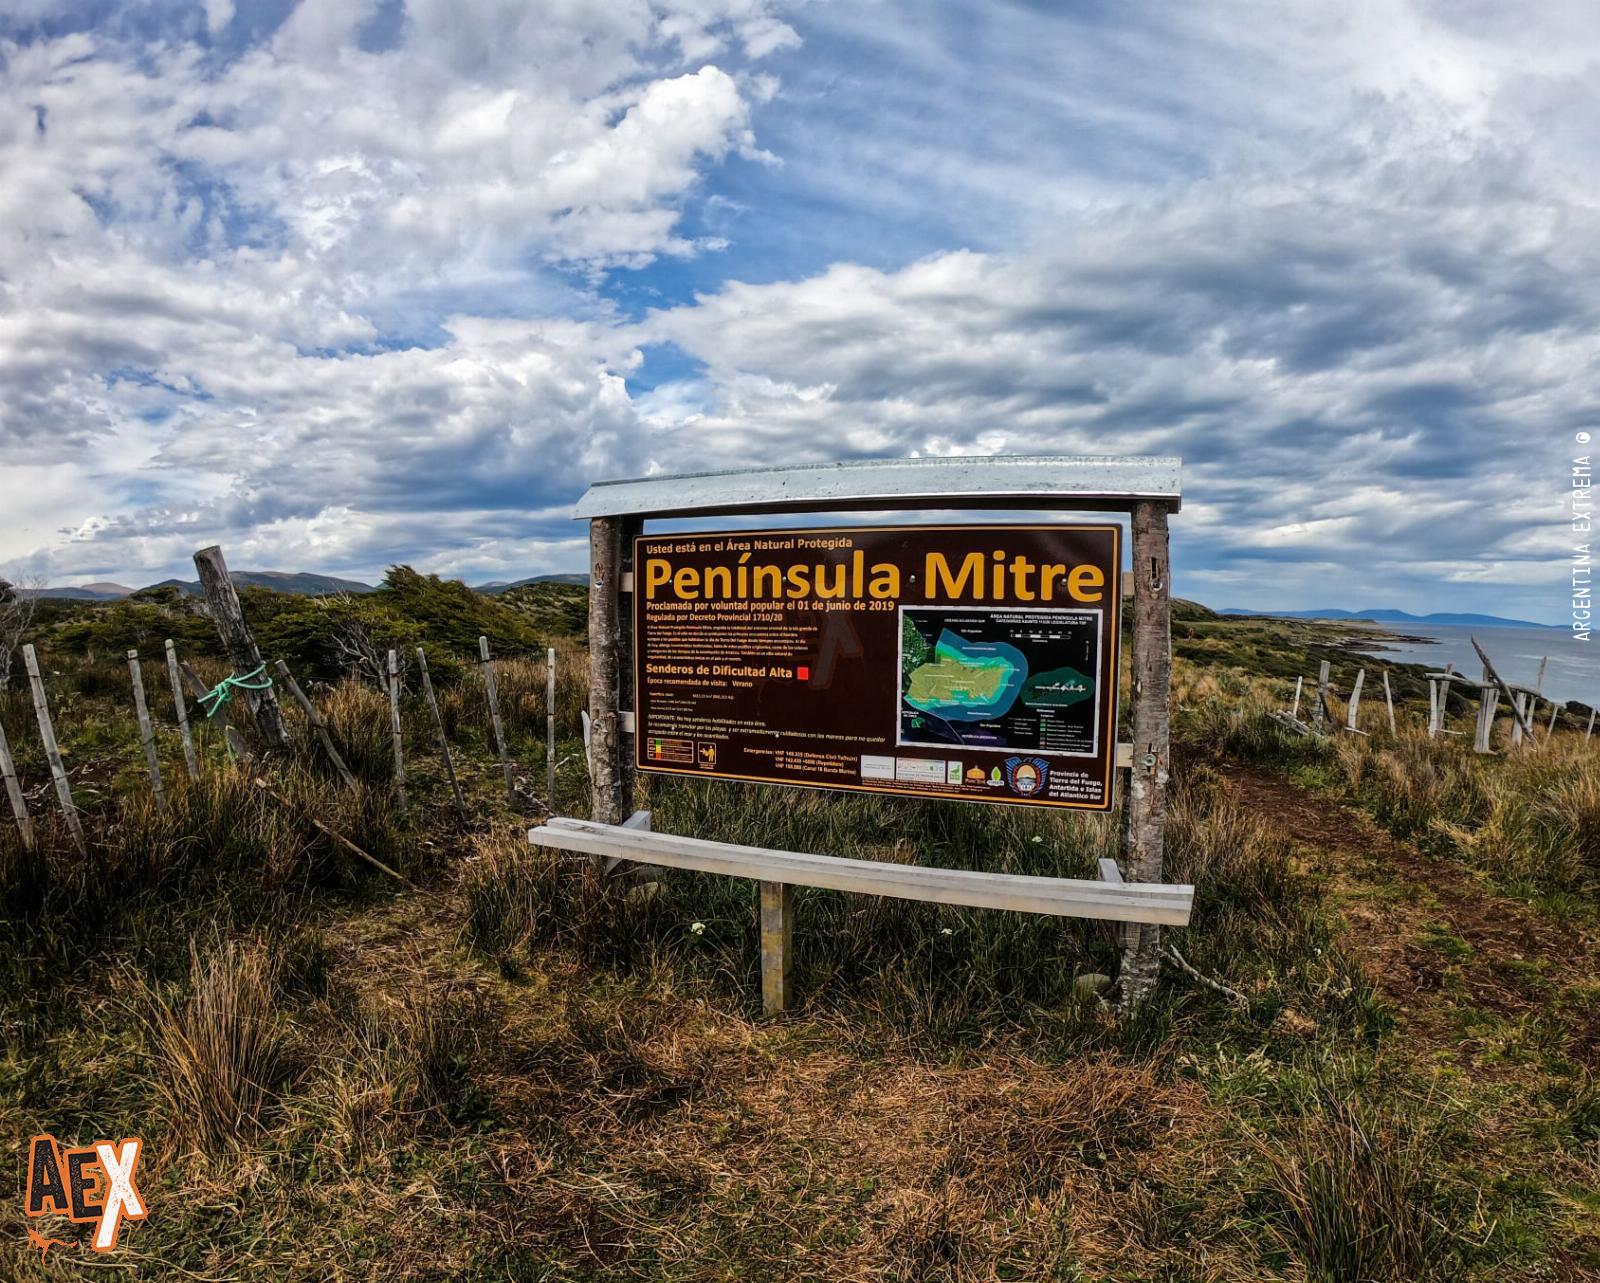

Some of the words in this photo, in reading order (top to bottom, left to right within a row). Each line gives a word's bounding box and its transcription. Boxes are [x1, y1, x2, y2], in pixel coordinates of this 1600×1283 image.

[646, 543, 673, 554] Usted
[675, 541, 696, 553] está
[699, 543, 711, 552] en
[714, 541, 723, 552] el
[726, 538, 751, 551] Área
[754, 538, 794, 551] Natural
[797, 537, 853, 550] Protegida
[646, 550, 900, 600] Península
[924, 551, 1104, 602] Mitre
[646, 600, 692, 611] Proclamada
[694, 602, 709, 613] por
[710, 600, 748, 611] voluntad
[750, 600, 784, 612] popular
[786, 600, 796, 610] el
[797, 600, 810, 611] 01
[812, 600, 824, 611] de
[825, 600, 852, 612] junio
[853, 600, 866, 611] de
[868, 600, 895, 611] 2019
[646, 613, 676, 623] Regulada
[676, 614, 688, 623] por
[689, 613, 716, 622] Decreto
[717, 613, 751, 622] Provincial
[753, 613, 783, 622] 1710/20
[646, 664, 694, 675] Senderos
[696, 664, 710, 675] de
[712, 665, 766, 677] Dificultad
[769, 666, 793, 678] Alta
[732, 680, 753, 688] Verano
[1049, 770, 1080, 778] Provincia
[1081, 779, 1103, 787] Fuego,
